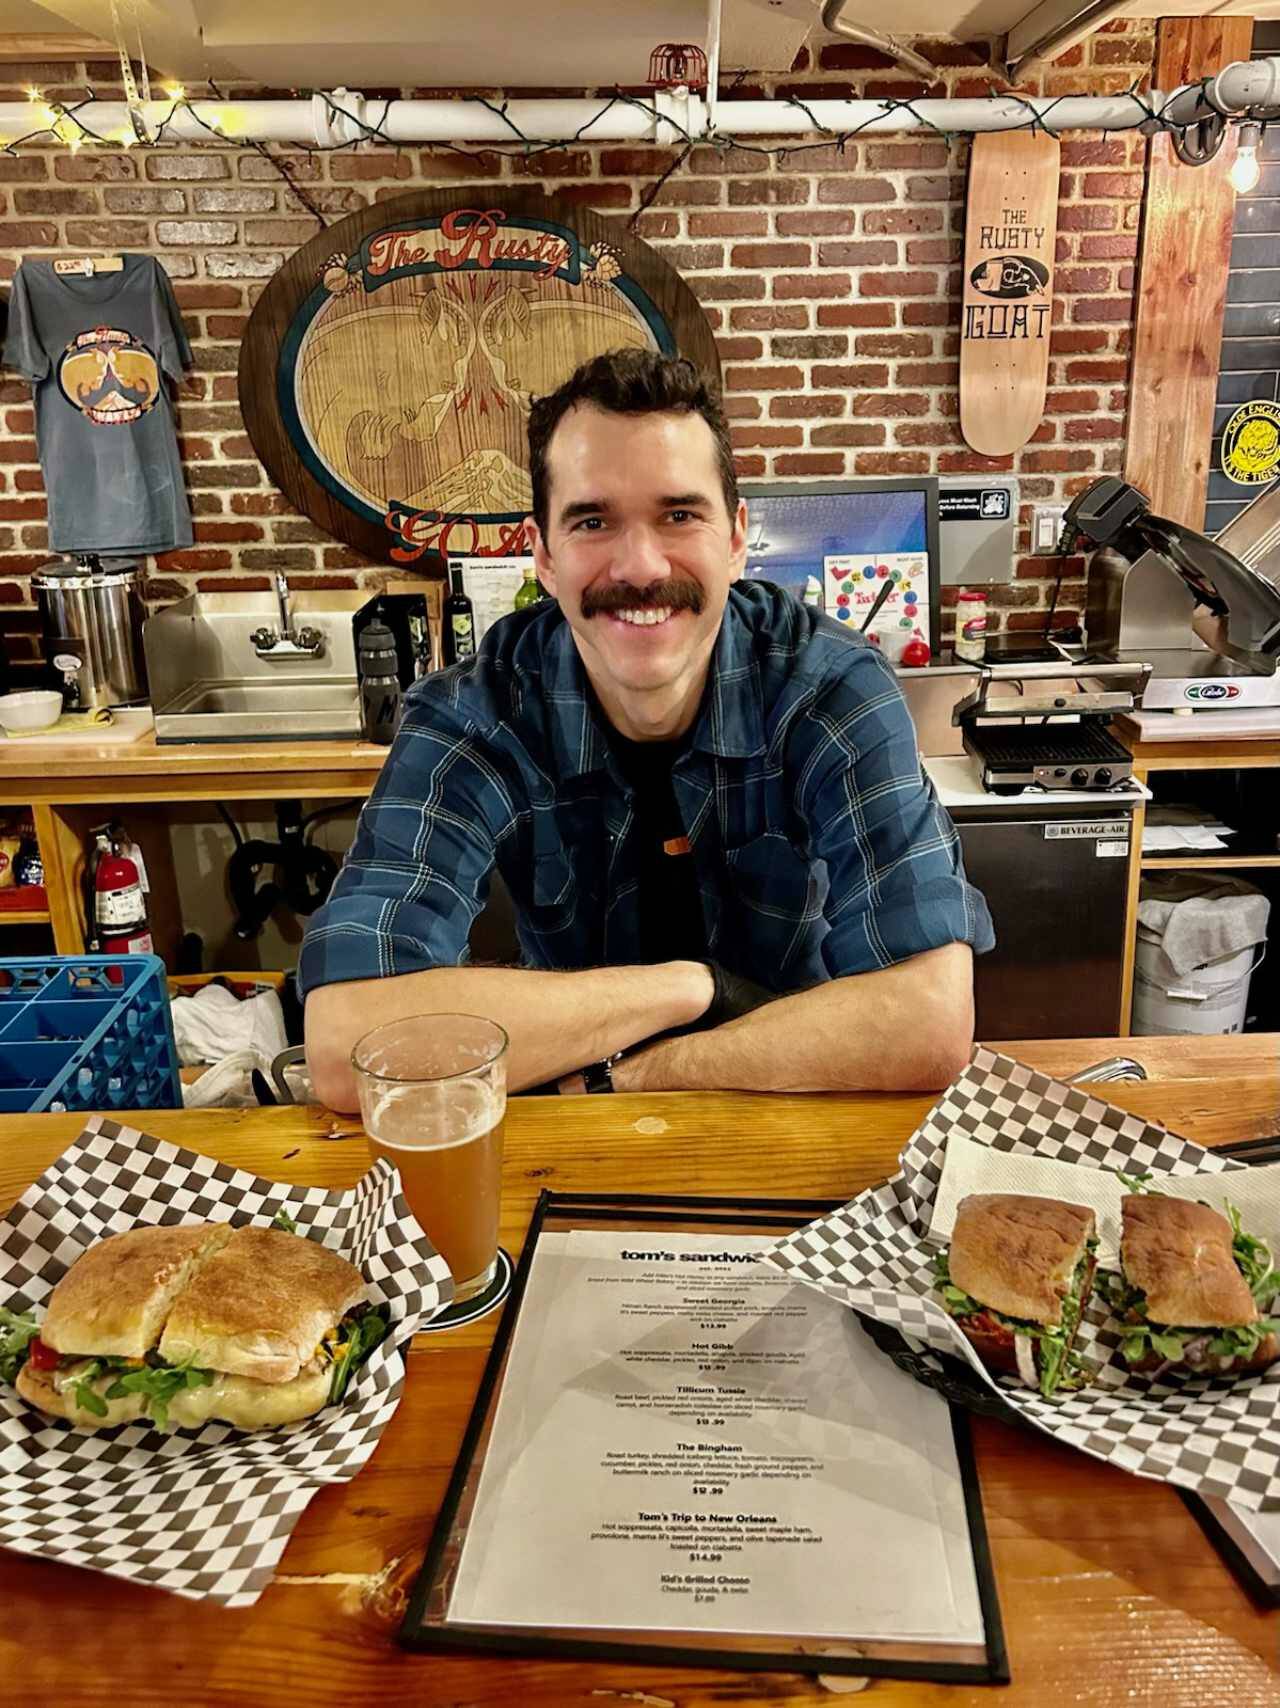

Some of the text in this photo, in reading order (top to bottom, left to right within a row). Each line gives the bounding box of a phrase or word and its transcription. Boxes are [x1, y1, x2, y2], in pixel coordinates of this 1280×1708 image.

[1003, 210, 1027, 224] THE
[980, 226, 1045, 249] RUSTY
[367, 208, 573, 281] The Rusty
[964, 304, 1050, 339] GOAT
[1233, 468, 1251, 481] THE
[384, 509, 527, 562] GOA
[622, 1250, 676, 1261] tom's
[711, 1298, 746, 1306] Georgia
[692, 1342, 709, 1350] Hot
[677, 1385, 715, 1394] Tillicum
[677, 1443, 743, 1453] The Bingham
[638, 1512, 778, 1524] Tom's Trip to New Orleans
[689, 1552, 722, 1562] $14.99
[660, 1575, 751, 1585] Kid's Grilled Cheese
